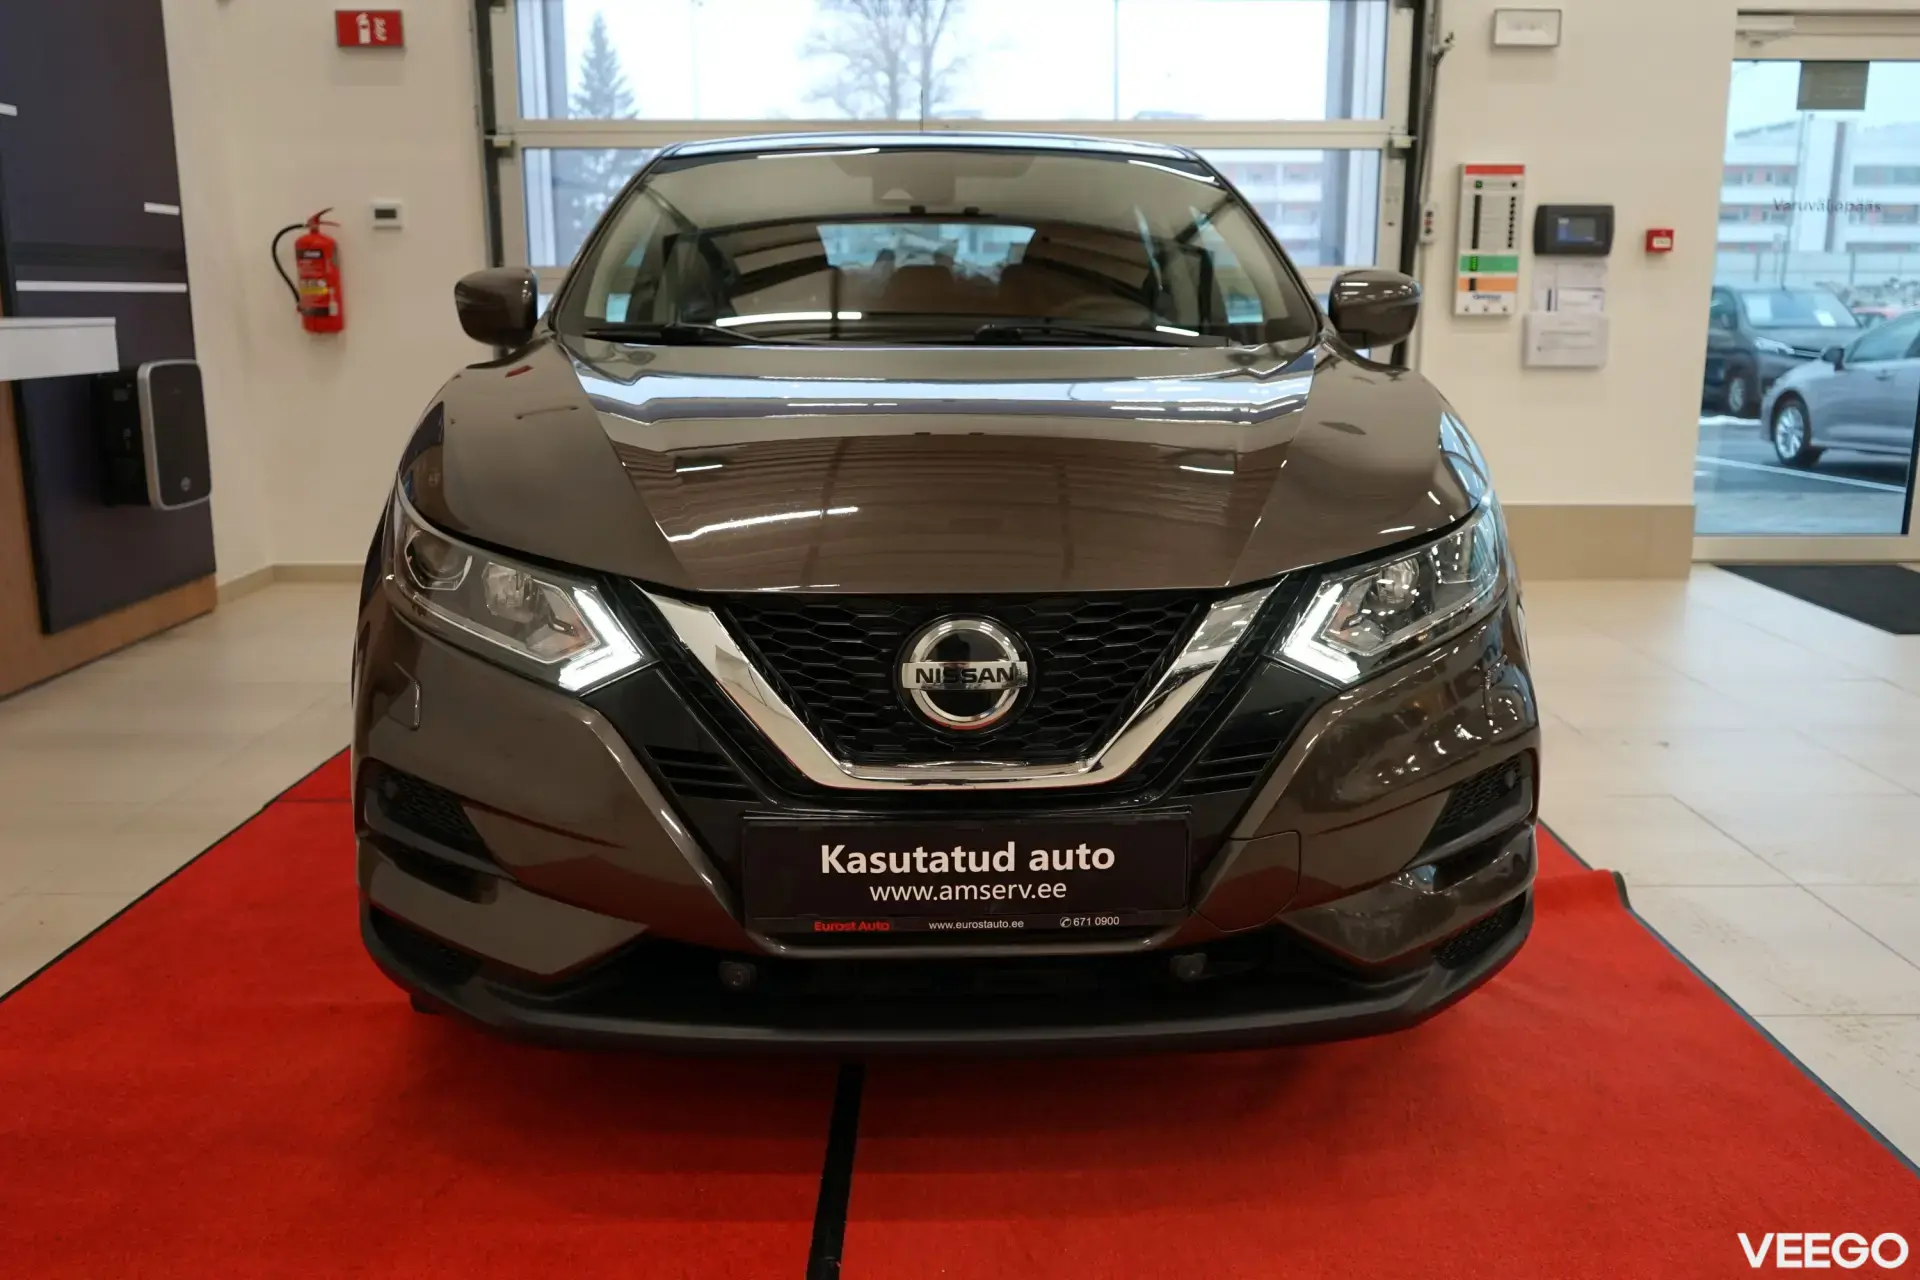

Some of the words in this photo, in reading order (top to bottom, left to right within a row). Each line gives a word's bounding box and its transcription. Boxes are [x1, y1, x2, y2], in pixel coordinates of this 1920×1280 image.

[915, 667, 1015, 684] NISSAN
[821, 841, 1016, 874] Kasutatud
[1028, 843, 1115, 872] auto
[869, 882, 1067, 901] www.amserv.ee
[814, 920, 857, 932] Eurost
[858, 920, 891, 932] Auto
[929, 920, 1025, 930] www.eurostauto.ee
[1073, 917, 1091, 927] 671
[1094, 916, 1120, 926] 0900
